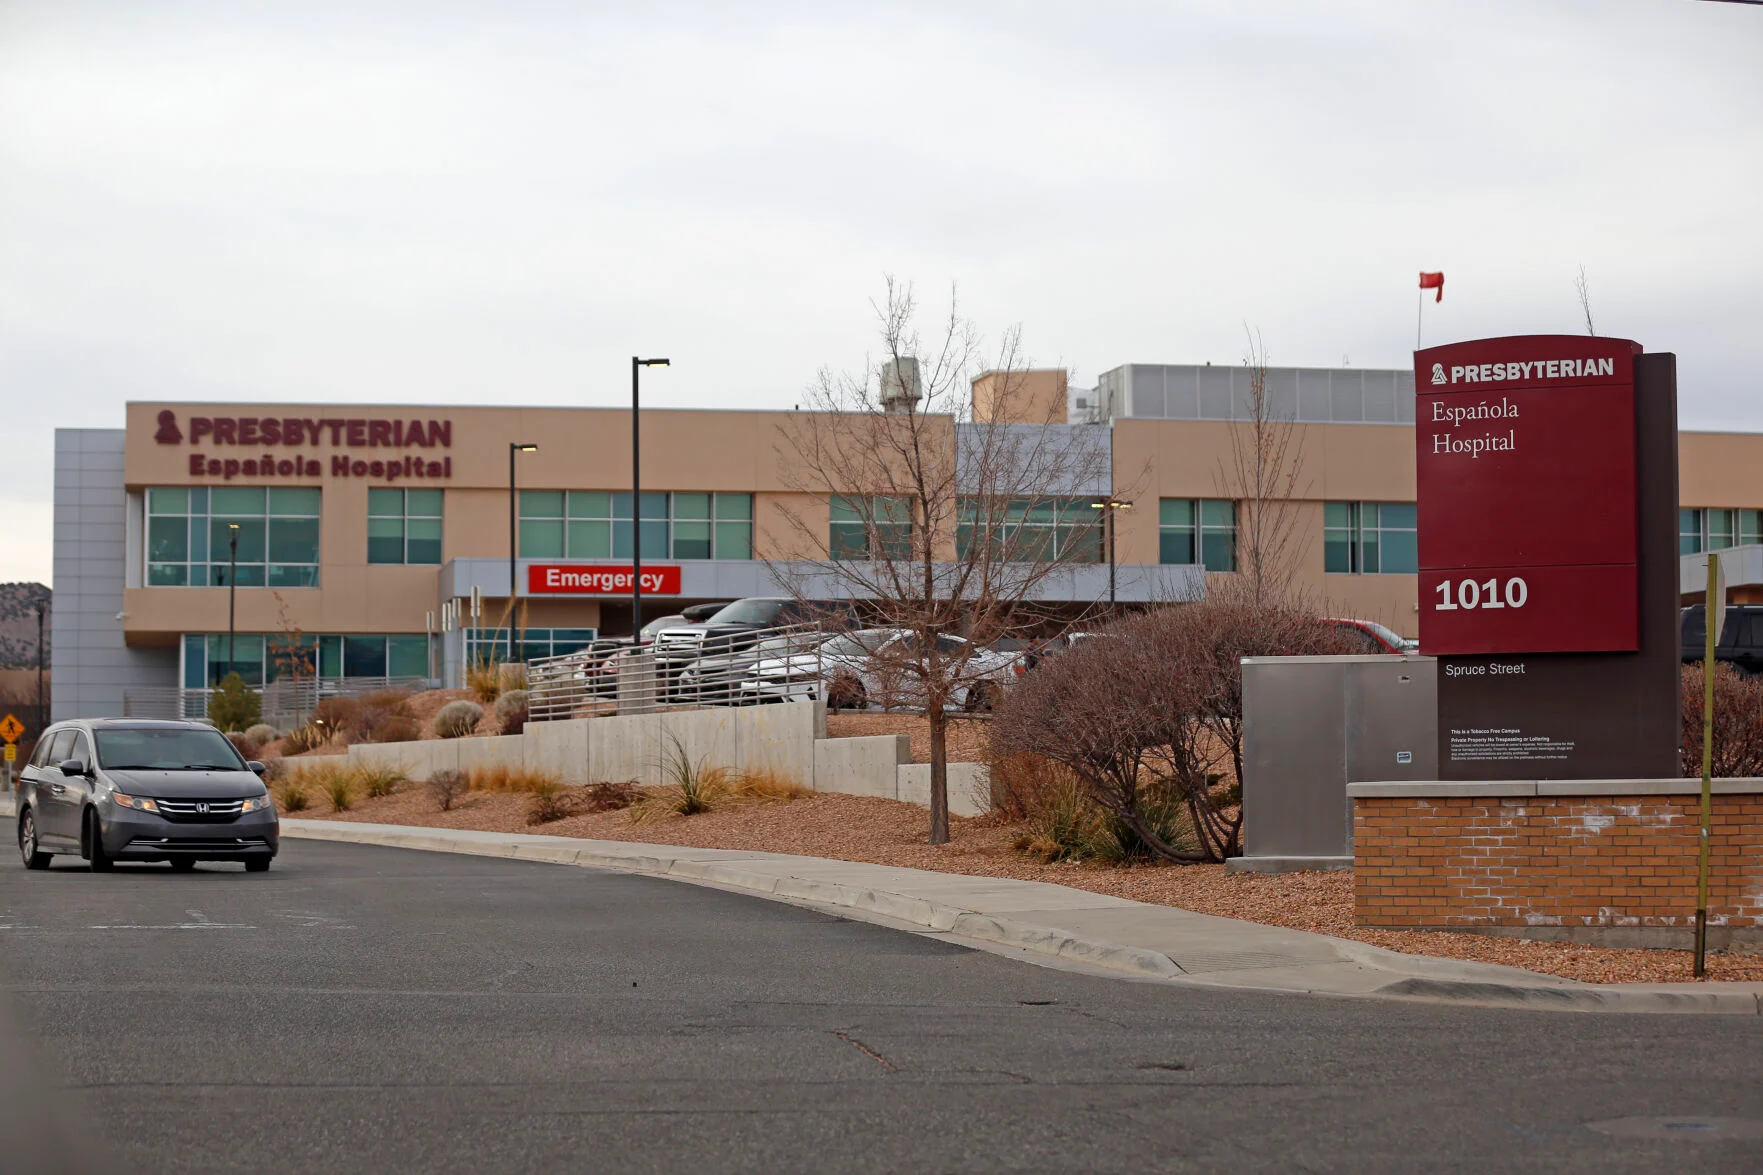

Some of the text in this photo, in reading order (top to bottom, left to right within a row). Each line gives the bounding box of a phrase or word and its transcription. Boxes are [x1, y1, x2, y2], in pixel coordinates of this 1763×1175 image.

[1451, 358, 1614, 384] PRESBYTERIAN
[1431, 397, 1520, 427] Española
[189, 417, 452, 447] PRESBYTERIAN
[1432, 429, 1516, 459] Hospital
[189, 454, 452, 481] Española Hospital
[546, 568, 664, 592] Emergency
[1435, 576, 1528, 611] 1010
[1445, 663, 1526, 677] Spruce Street
